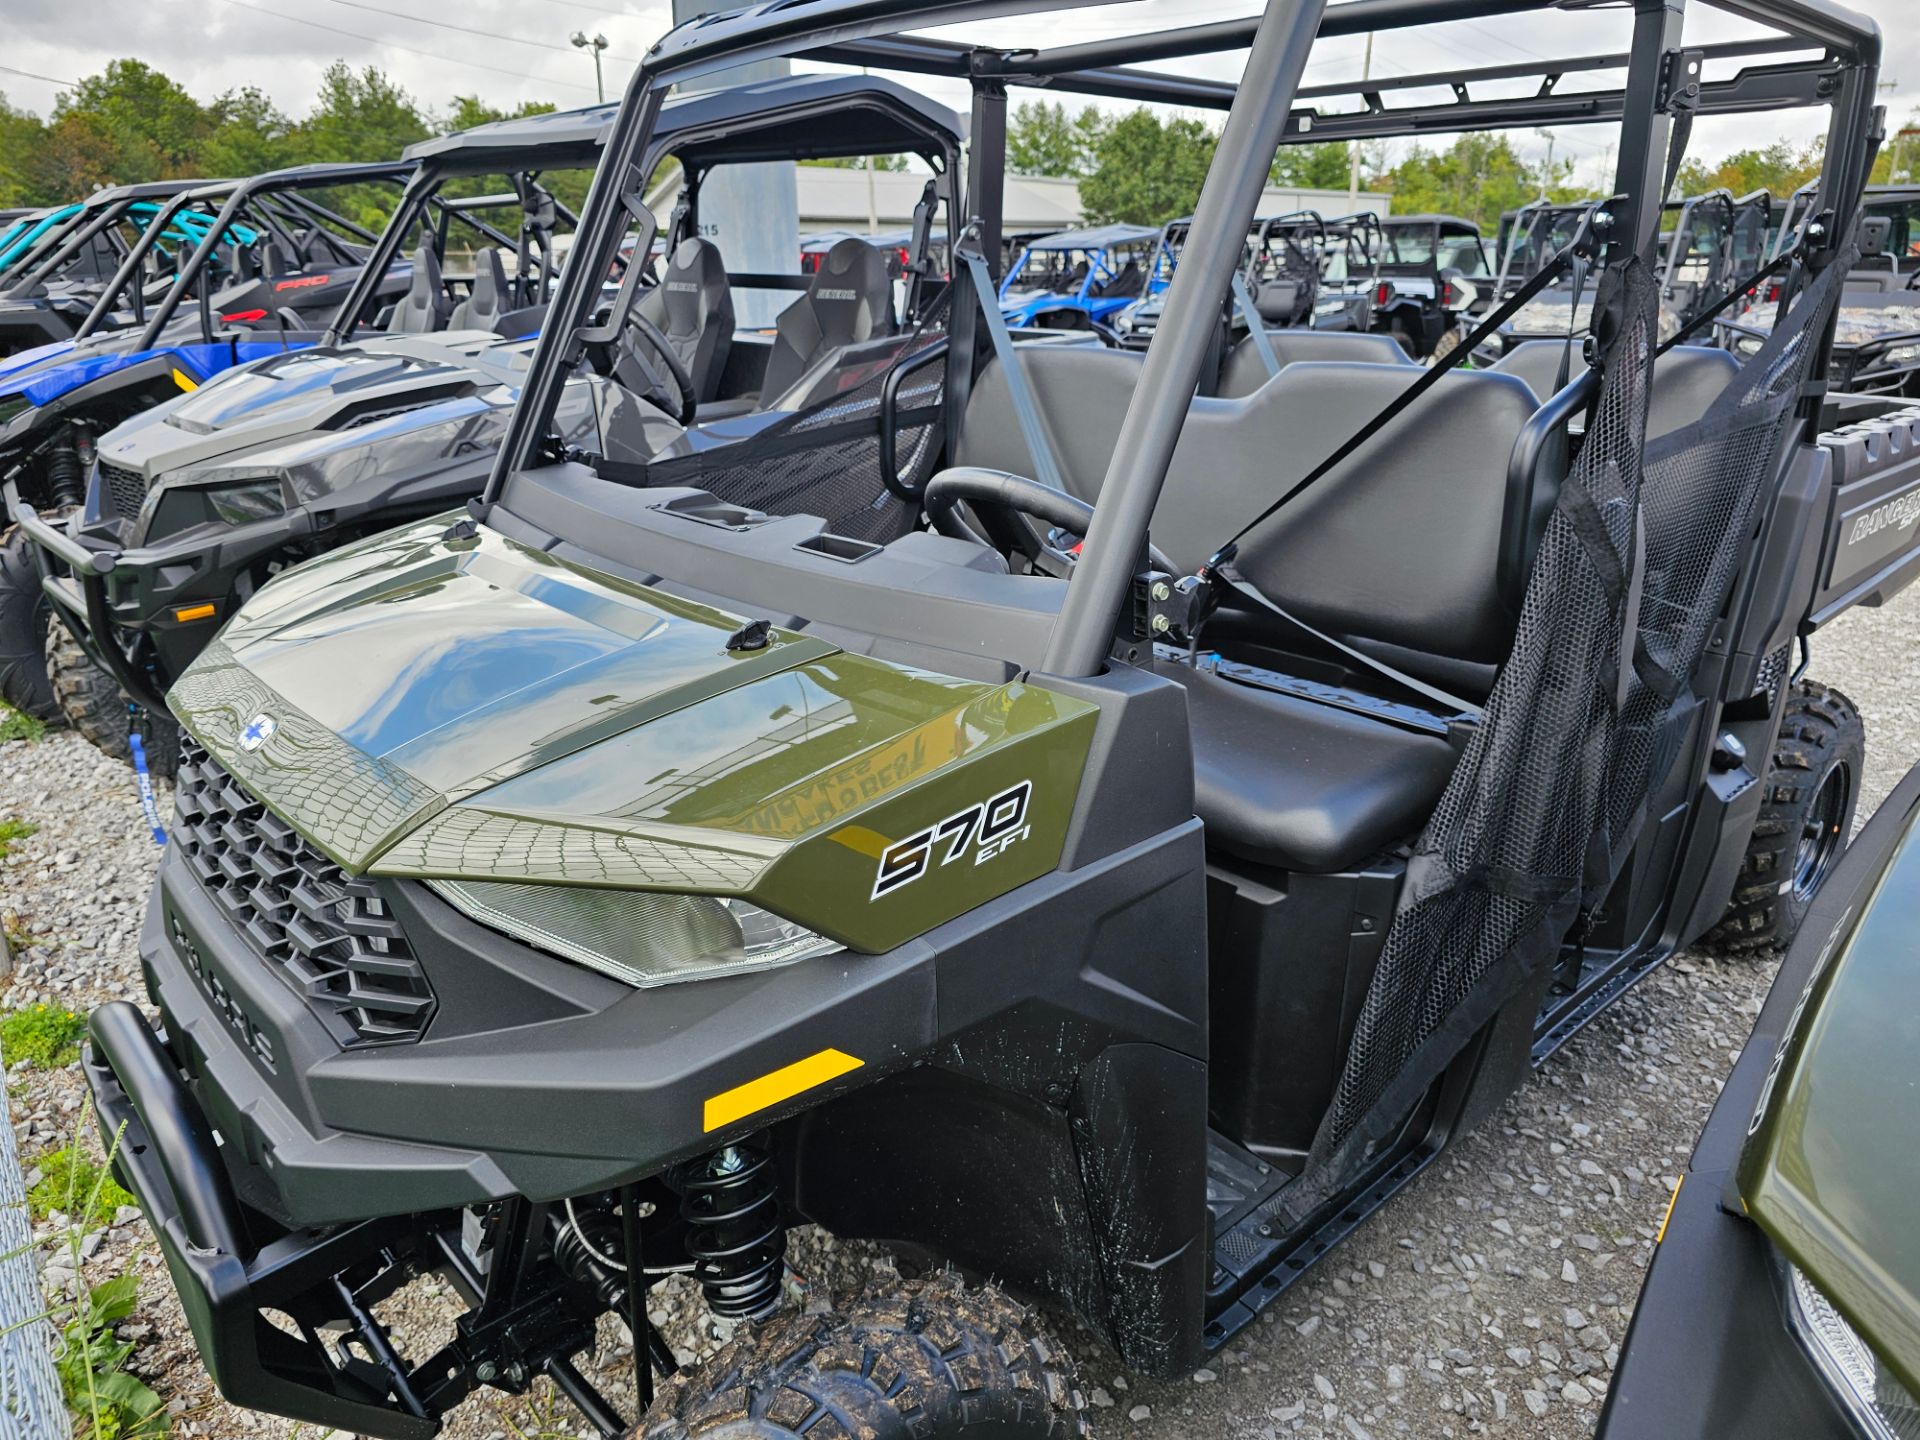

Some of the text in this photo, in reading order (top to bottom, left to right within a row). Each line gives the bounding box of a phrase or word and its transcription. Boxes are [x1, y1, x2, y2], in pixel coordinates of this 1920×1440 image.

[275, 275, 329, 292] PRO
[1848, 489, 1920, 545] RANGE
[870, 780, 1033, 902] 570
[974, 825, 1031, 867] EFI
[169, 909, 278, 1076] POLARIS
